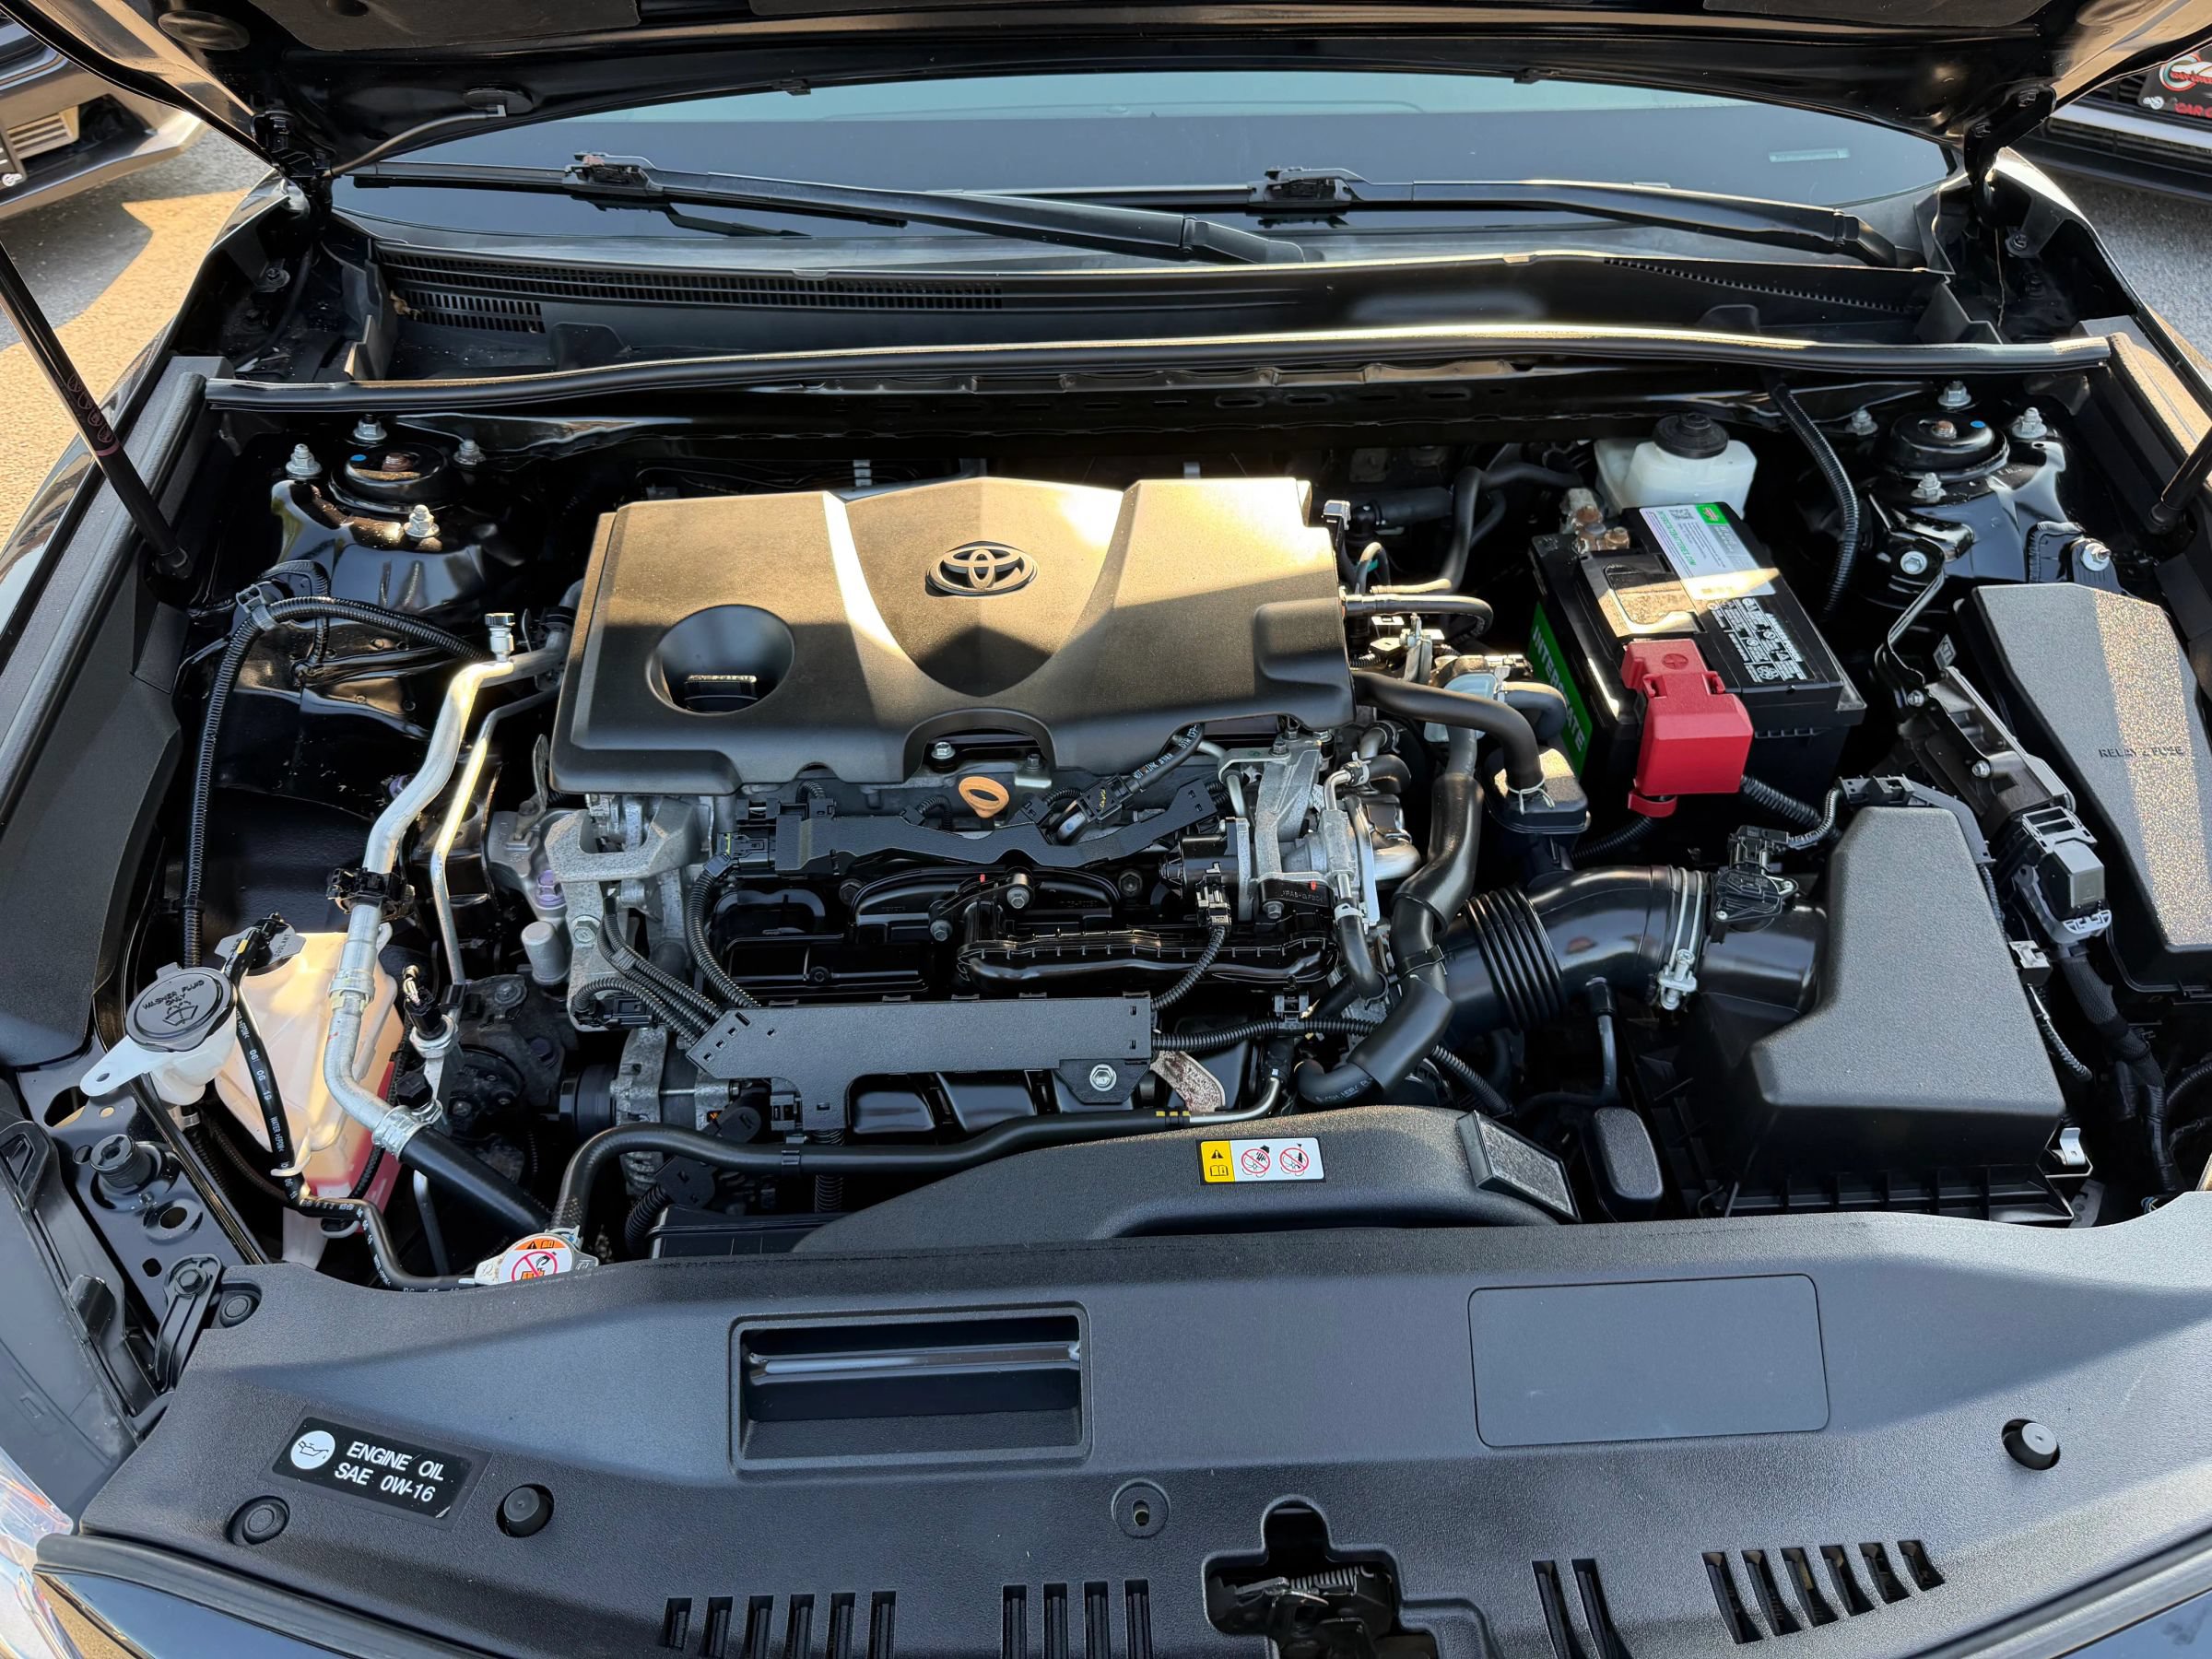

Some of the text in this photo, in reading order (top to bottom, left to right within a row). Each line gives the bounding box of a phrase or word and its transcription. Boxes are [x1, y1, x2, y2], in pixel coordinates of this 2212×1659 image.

[1533, 626, 1584, 752] INTERATE
[2098, 747, 2137, 758] RELAY
[2151, 746, 2184, 757] FUSE
[274, 934, 291, 957] COOLANT
[142, 979, 205, 1010] WASHER FLUID
[165, 994, 186, 1006] ONLY
[346, 1441, 445, 1482] ENGINE OIL
[334, 1462, 437, 1502] SAE 0W-16
